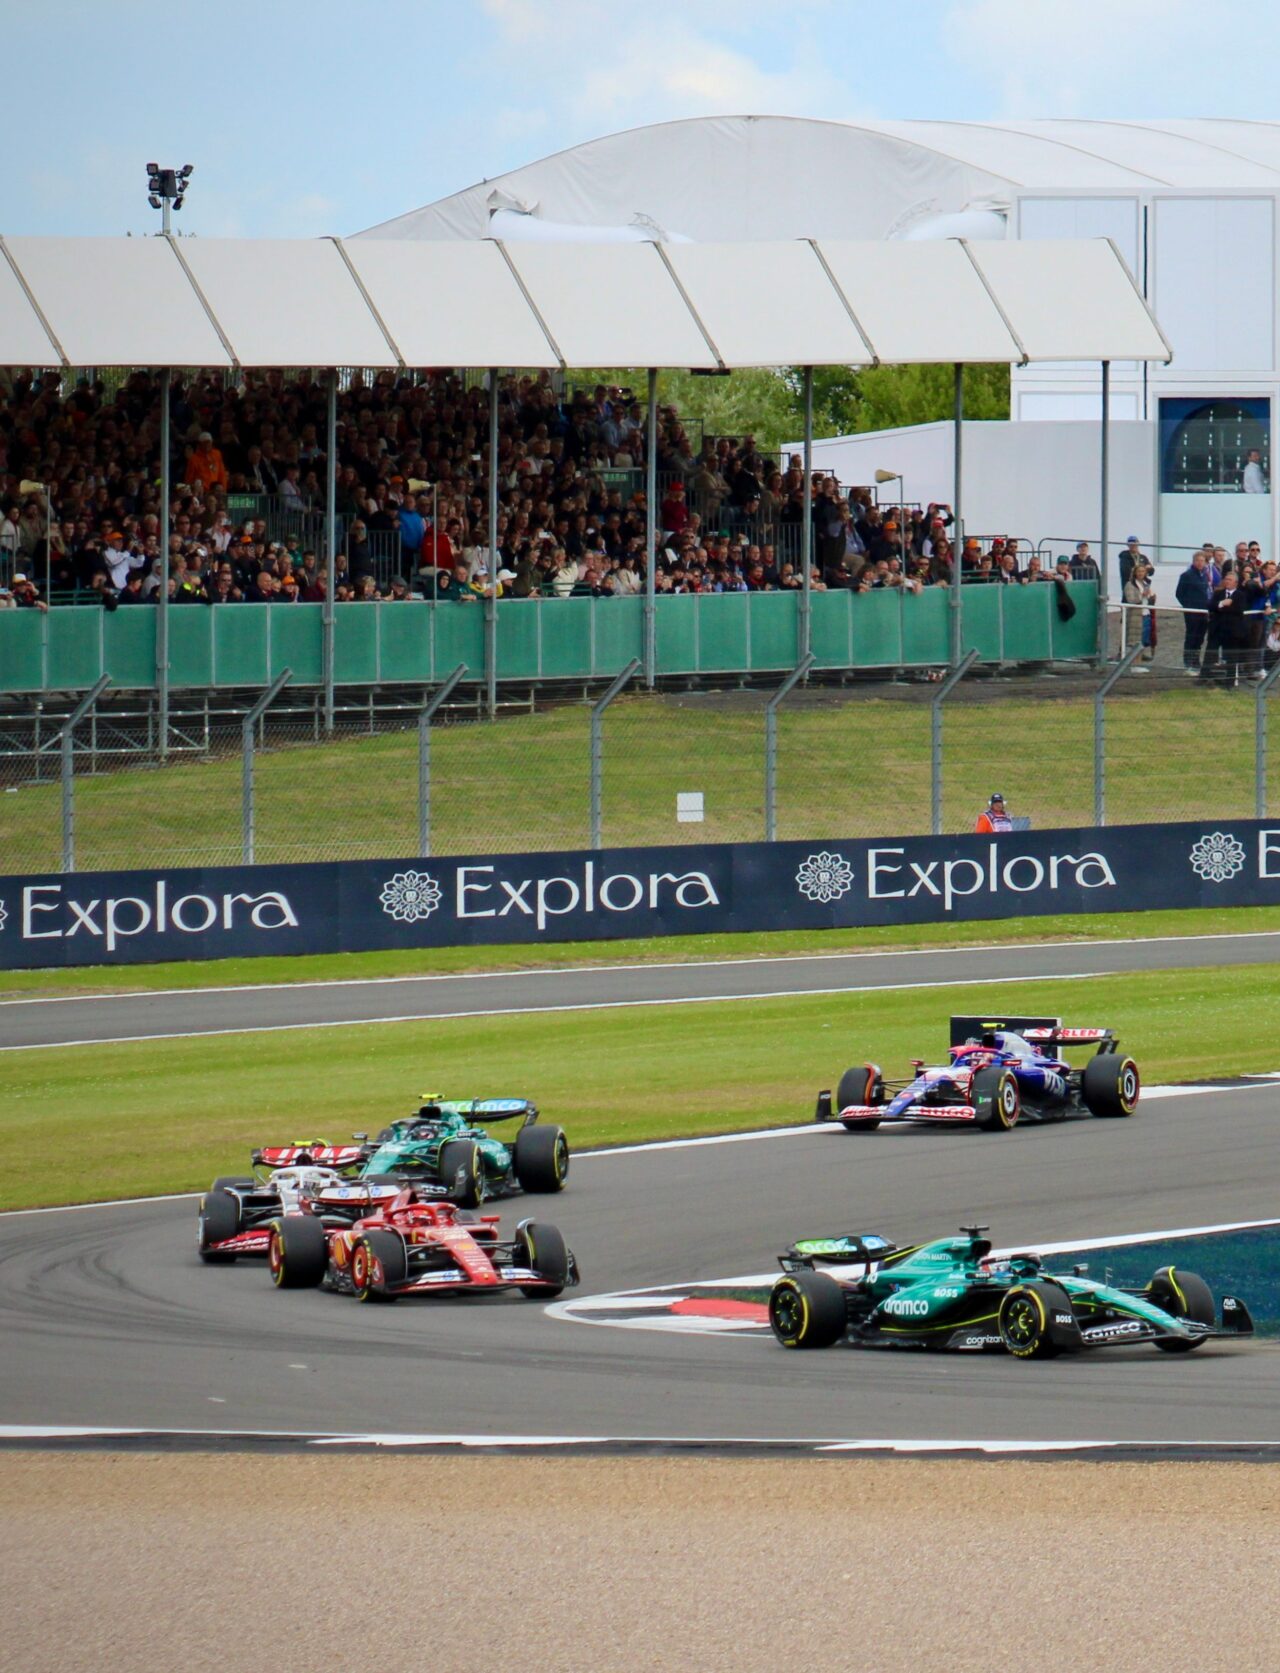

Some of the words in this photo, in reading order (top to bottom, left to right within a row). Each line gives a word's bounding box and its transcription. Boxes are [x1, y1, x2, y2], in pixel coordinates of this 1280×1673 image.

[456, 860, 720, 930] Explora
[867, 842, 1117, 911] Explora
[22, 880, 299, 952] Explora
[884, 1300, 929, 1315] aramco
[1056, 1315, 1072, 1323] BOSS
[966, 1334, 1004, 1346] cognizan
